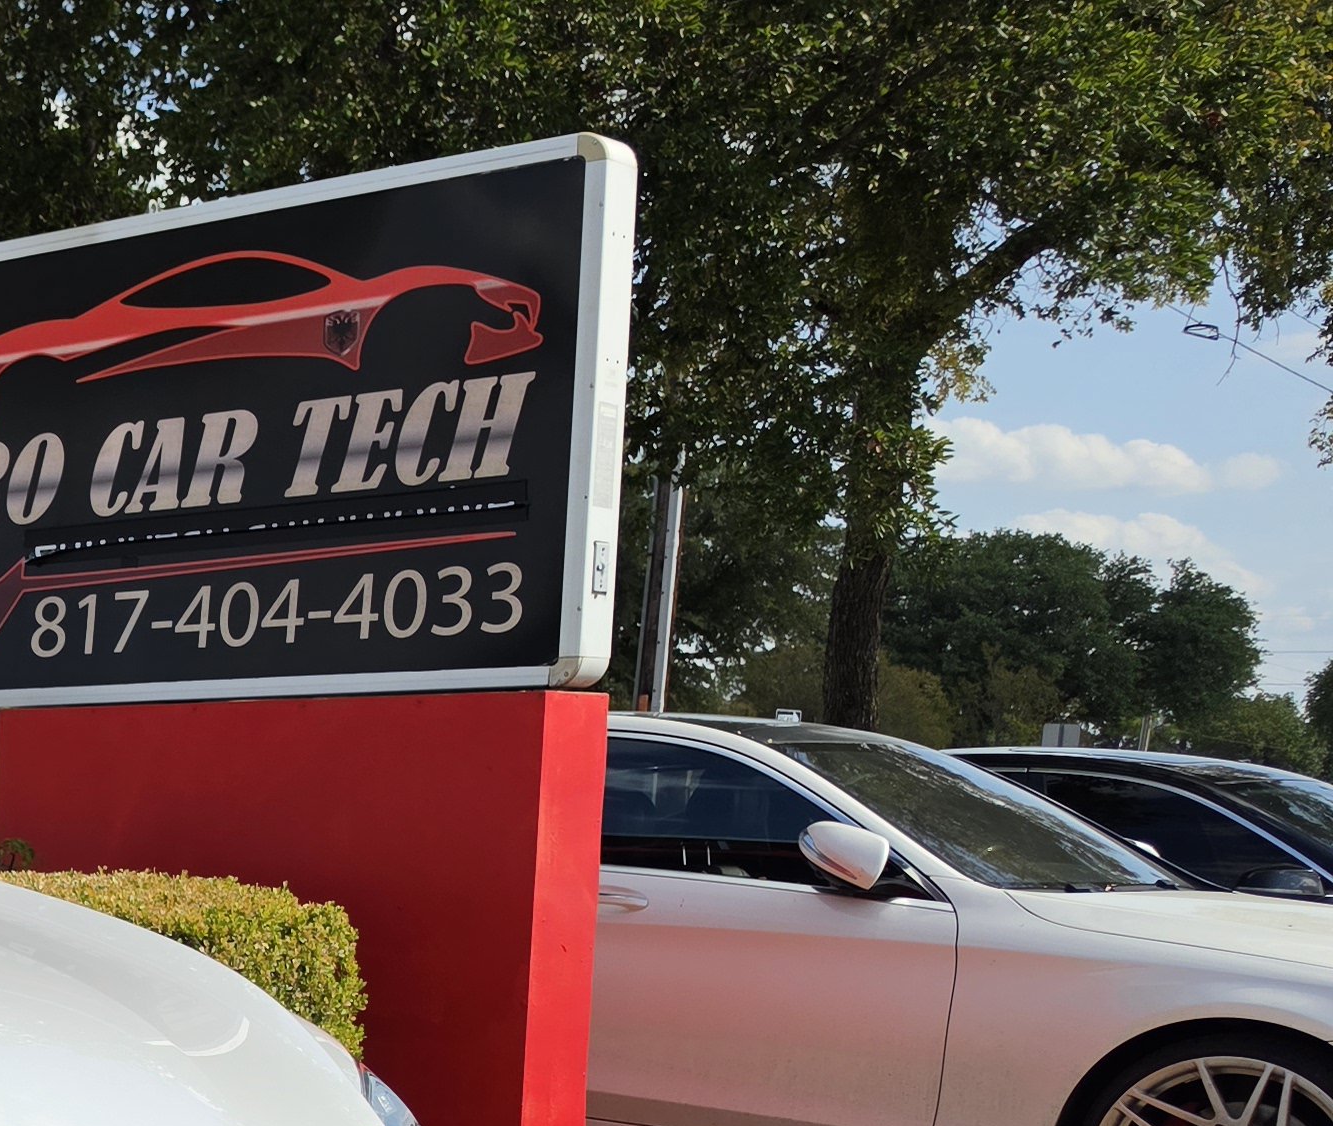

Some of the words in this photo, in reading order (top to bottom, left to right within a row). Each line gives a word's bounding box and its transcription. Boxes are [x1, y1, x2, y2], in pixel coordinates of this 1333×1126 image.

[90, 409, 259, 517] CAR
[284, 371, 537, 498] TECH
[30, 561, 524, 658] 817-404-4033
